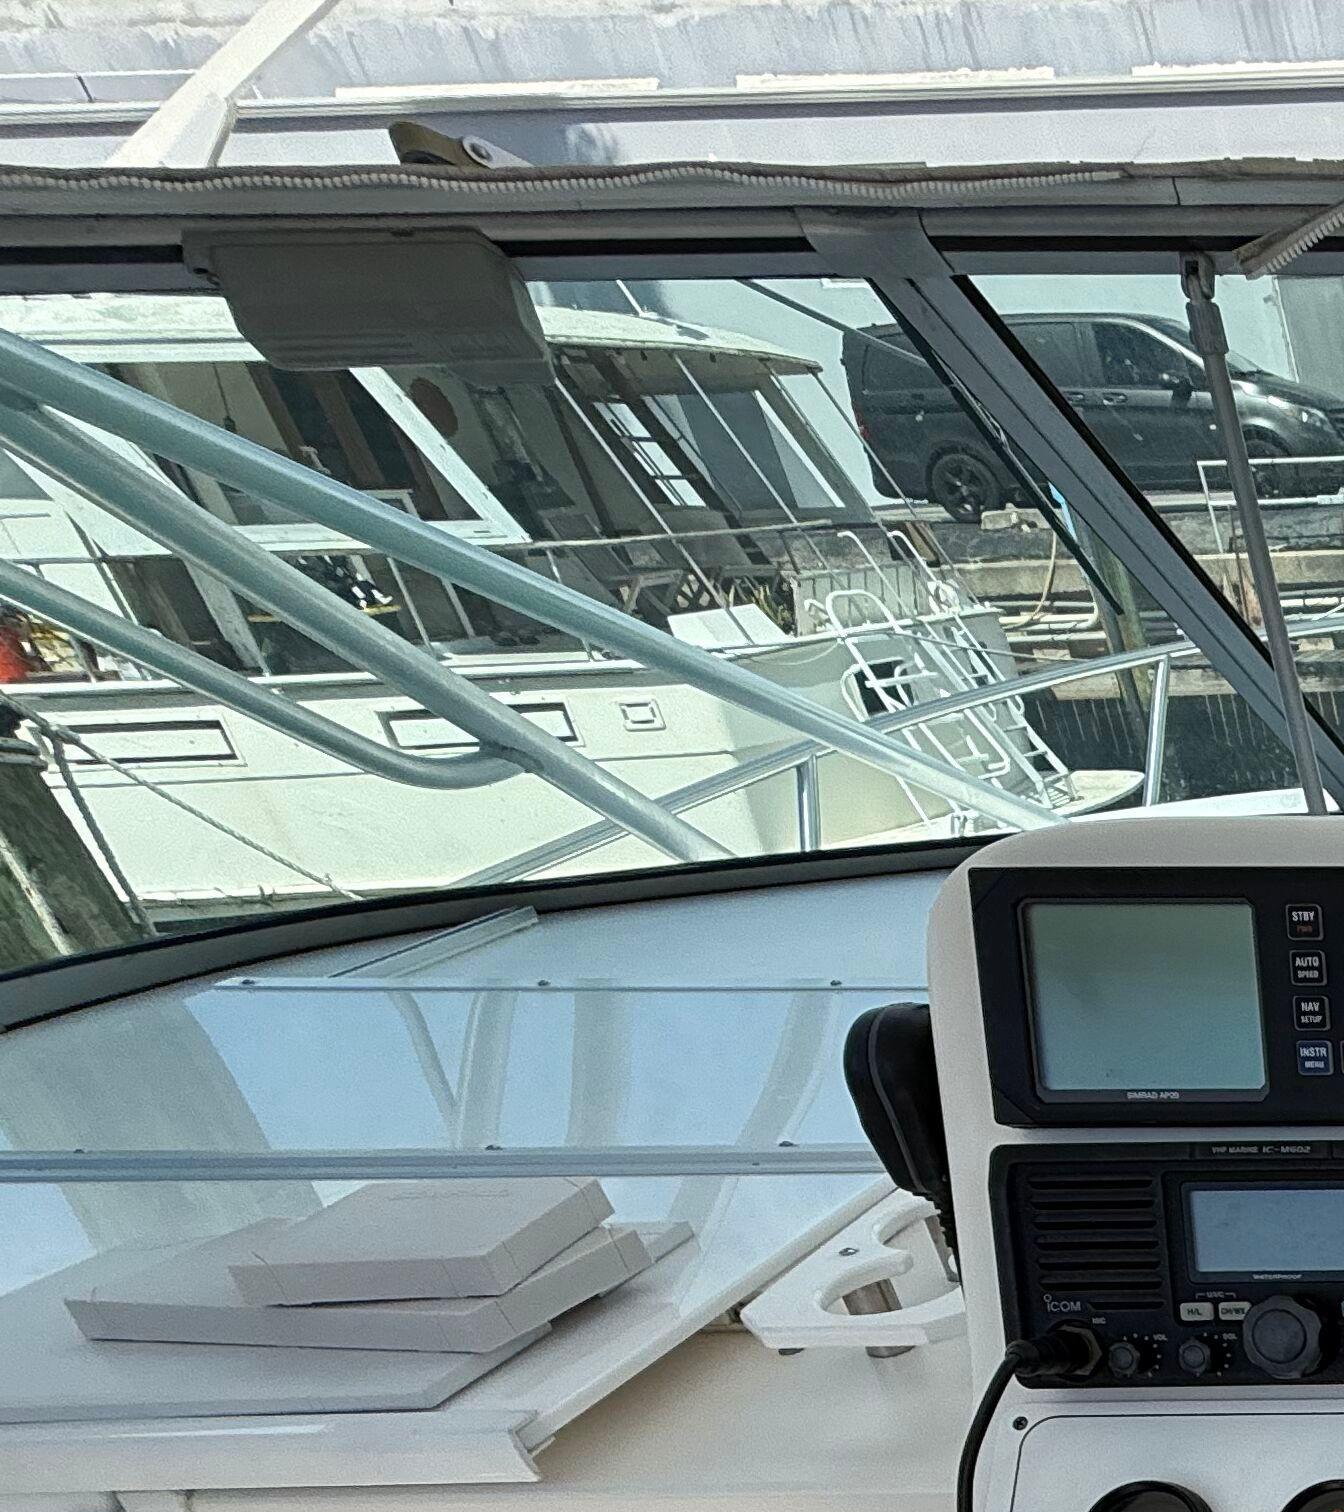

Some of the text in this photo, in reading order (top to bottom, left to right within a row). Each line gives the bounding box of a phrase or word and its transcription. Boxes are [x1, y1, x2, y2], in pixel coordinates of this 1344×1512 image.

[1292, 911, 1315, 921] STBY
[1295, 956, 1320, 967] AUTO
[1297, 970, 1319, 979] SPEED
[1301, 1002, 1320, 1012] NAV
[1299, 1047, 1327, 1057] INSTR
[1186, 1308, 1203, 1316] H/L
[1153, 1333, 1169, 1342] VOL
